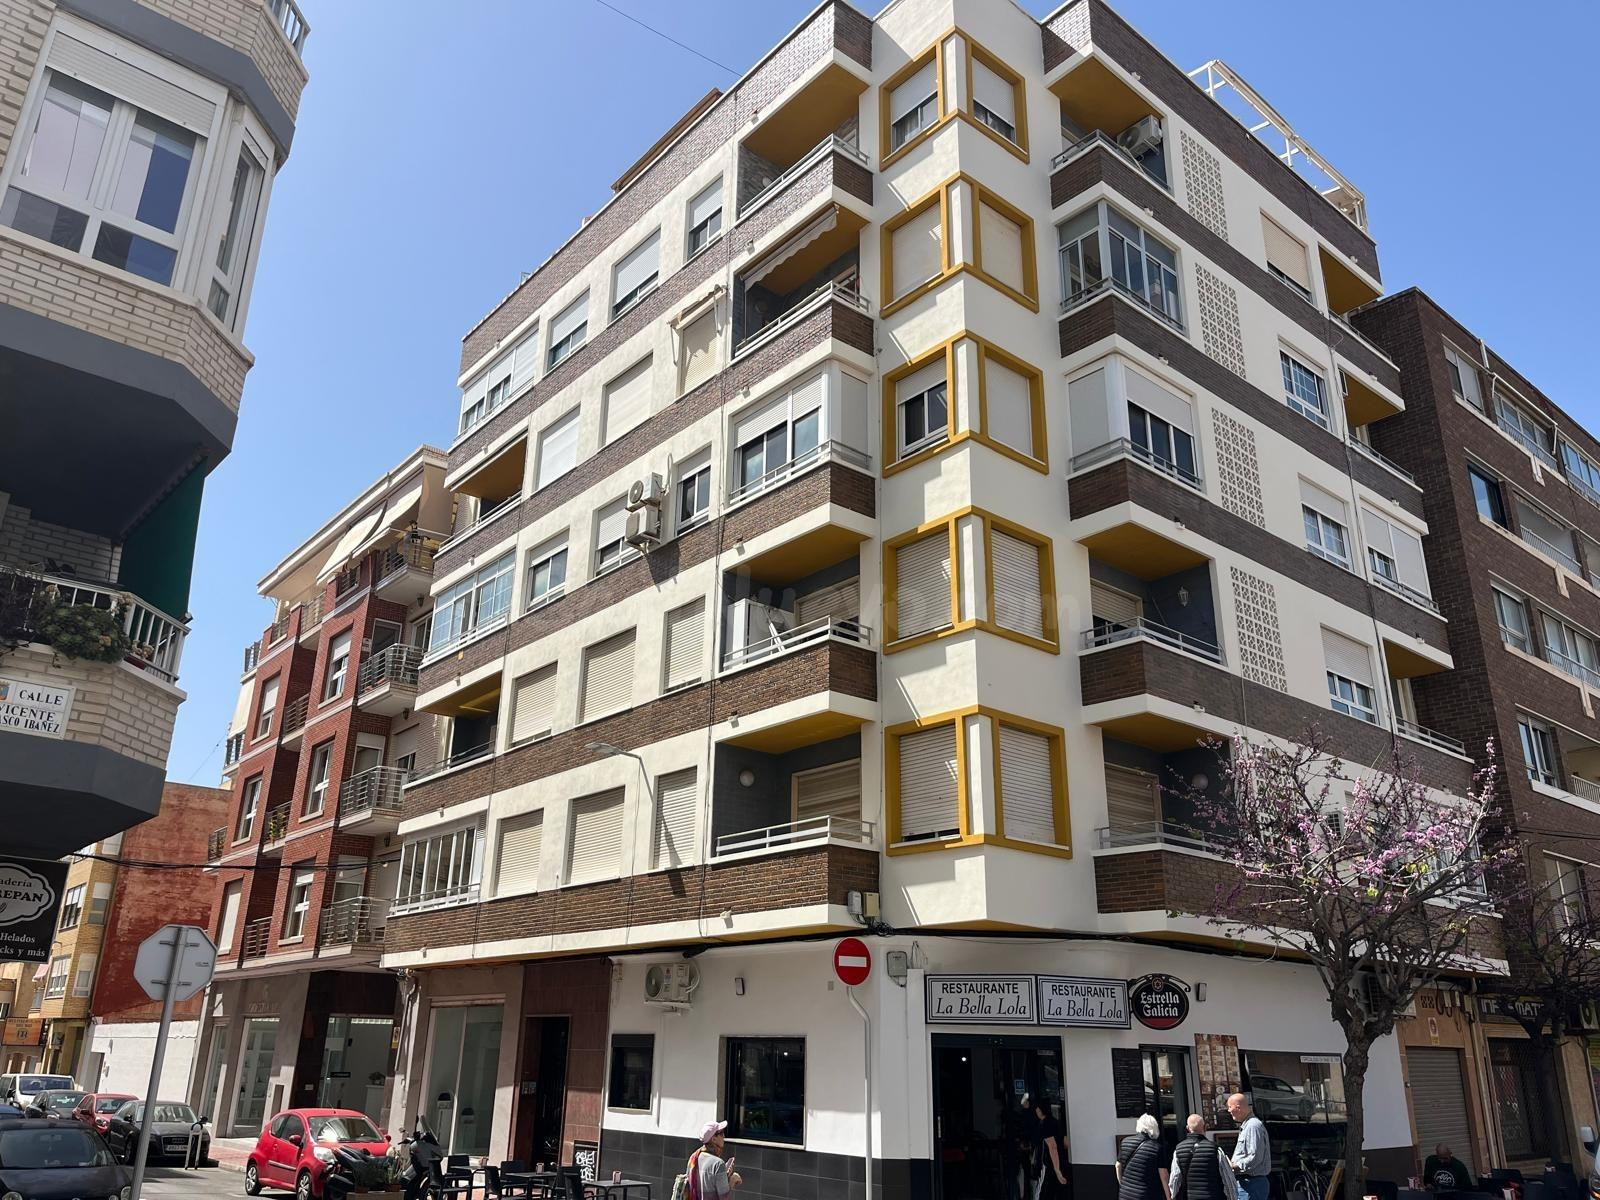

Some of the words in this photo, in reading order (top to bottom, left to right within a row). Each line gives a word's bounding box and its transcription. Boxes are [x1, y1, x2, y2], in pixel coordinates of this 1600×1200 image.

[19, 689, 64, 706] CALLE
[0, 714, 20, 727] SCO
[0, 932, 36, 943] Helados
[17, 948, 25, 957] y
[27, 947, 46, 957] más
[941, 982, 1019, 994] RESTAURANTE
[1051, 984, 1116, 999] RESTAURANTE
[1140, 991, 1180, 1004] Estrella
[936, 997, 953, 1014] La
[958, 994, 992, 1015] Bella
[996, 994, 1027, 1015] Lola
[1047, 998, 1063, 1016] La
[1066, 997, 1095, 1017] Bella
[1098, 999, 1123, 1019] Lola
[1142, 1004, 1179, 1017] Galicia
